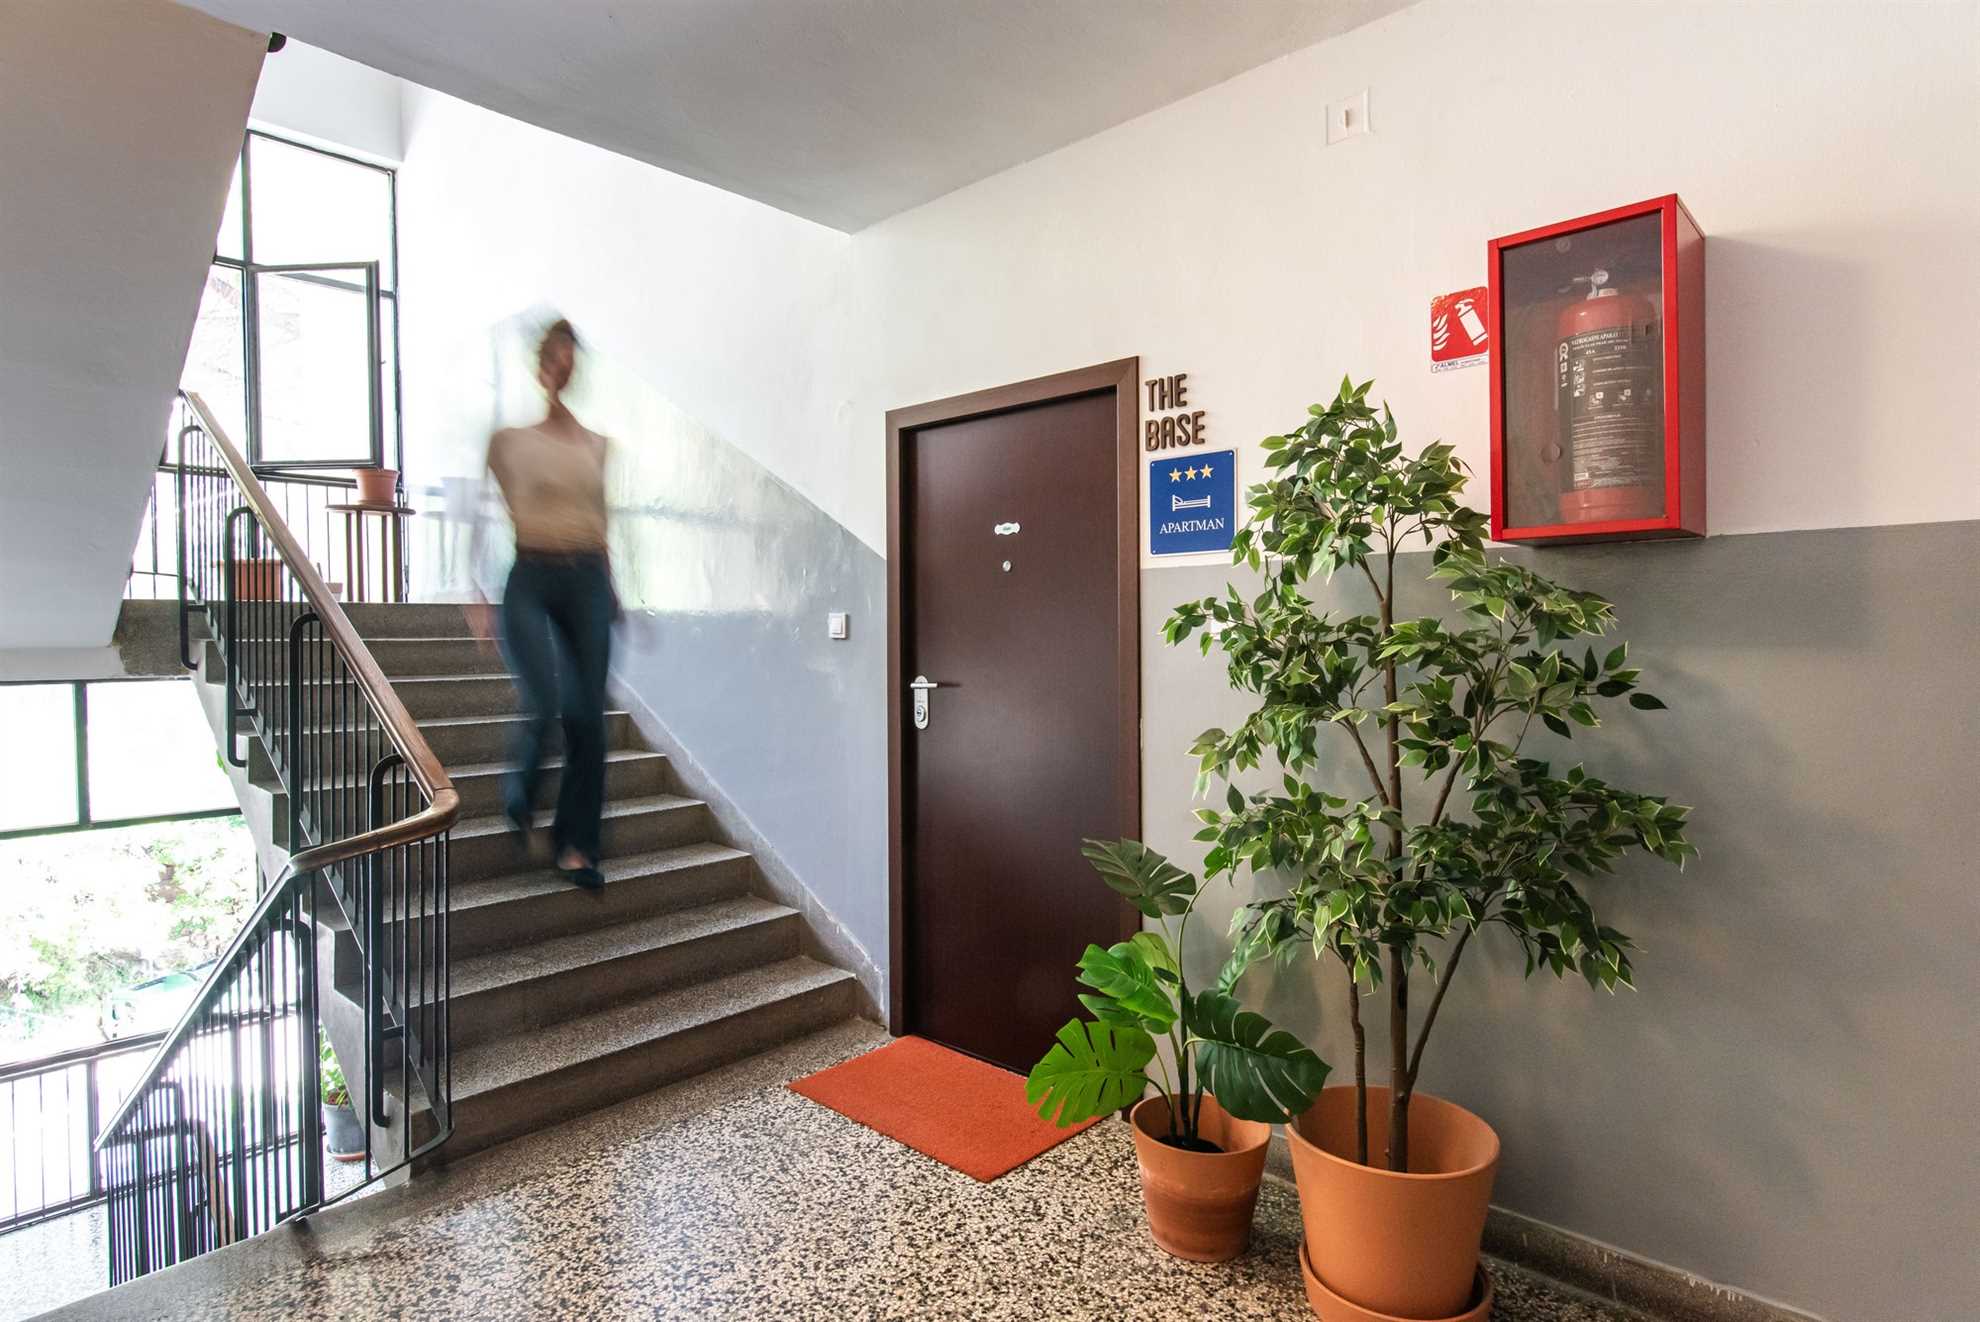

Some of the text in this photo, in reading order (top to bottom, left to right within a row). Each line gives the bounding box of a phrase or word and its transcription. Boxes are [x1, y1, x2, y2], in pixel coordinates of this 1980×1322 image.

[1145, 373, 1188, 412] THE
[1145, 410, 1206, 452] BASE
[1159, 517, 1225, 535] APARTMAN
